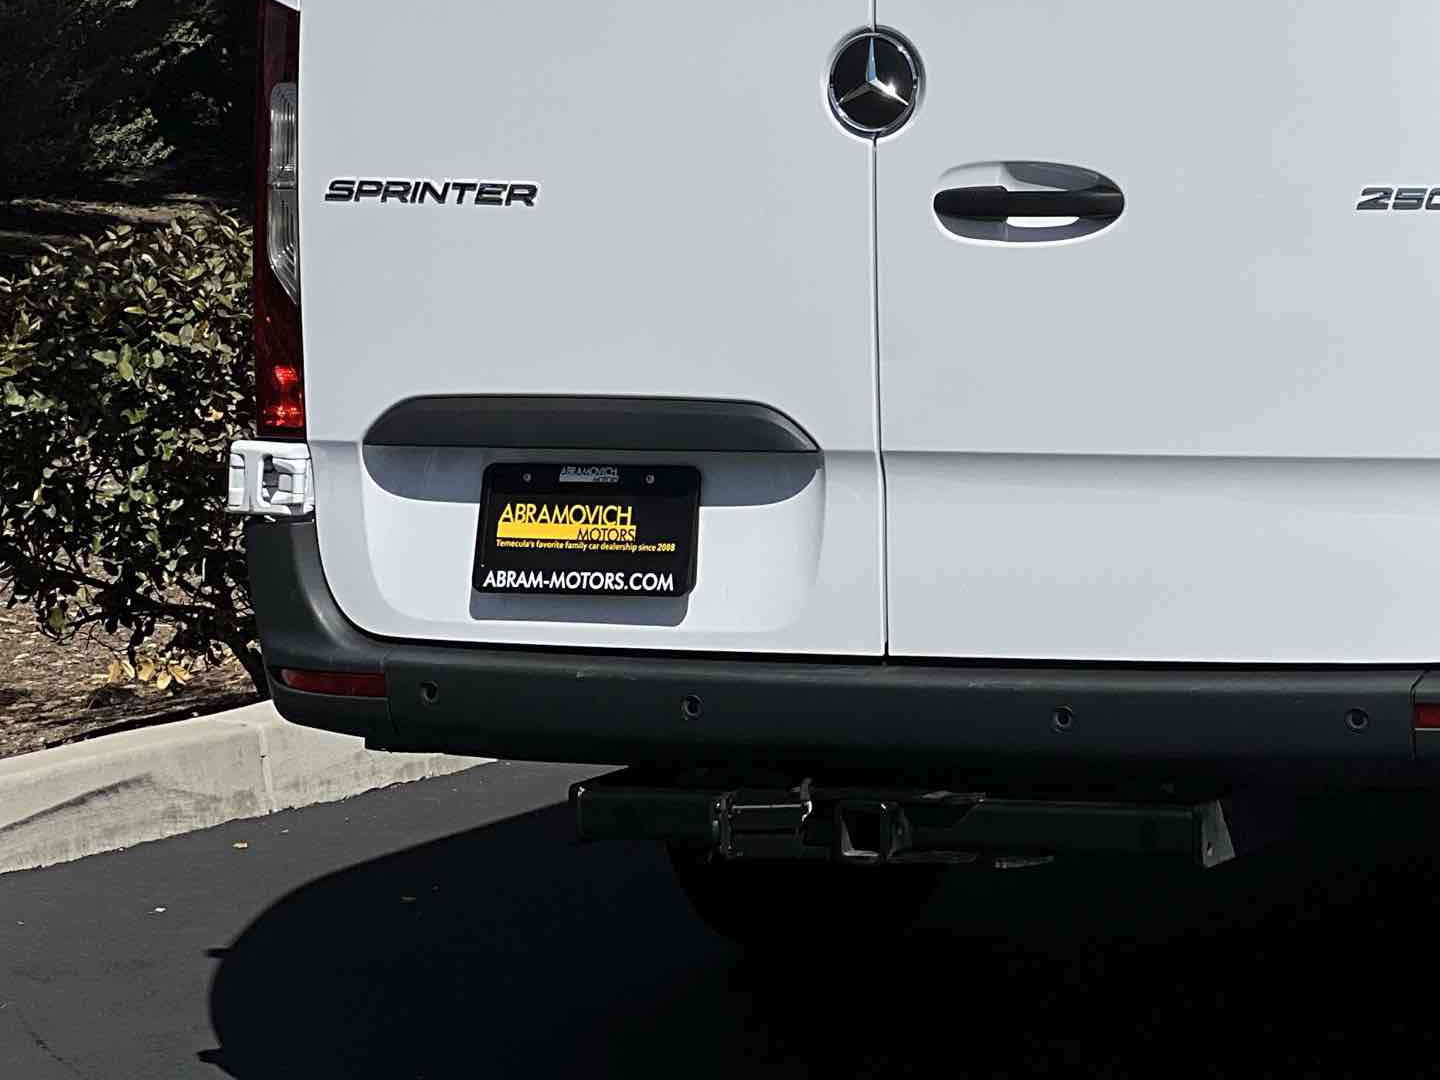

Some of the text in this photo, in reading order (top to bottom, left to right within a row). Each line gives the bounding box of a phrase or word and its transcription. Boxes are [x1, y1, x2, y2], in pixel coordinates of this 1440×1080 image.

[324, 179, 538, 207] SPRINTER
[498, 503, 633, 526] ABRAMOVICH
[496, 538, 535, 549] Temecula's
[535, 539, 564, 549] favorite
[564, 541, 588, 552] family
[588, 542, 600, 551] car
[600, 541, 638, 553] dealership
[638, 543, 657, 552] since
[576, 527, 636, 542] MOTORS
[482, 570, 674, 592] ABRAM-MOTORS.COM
